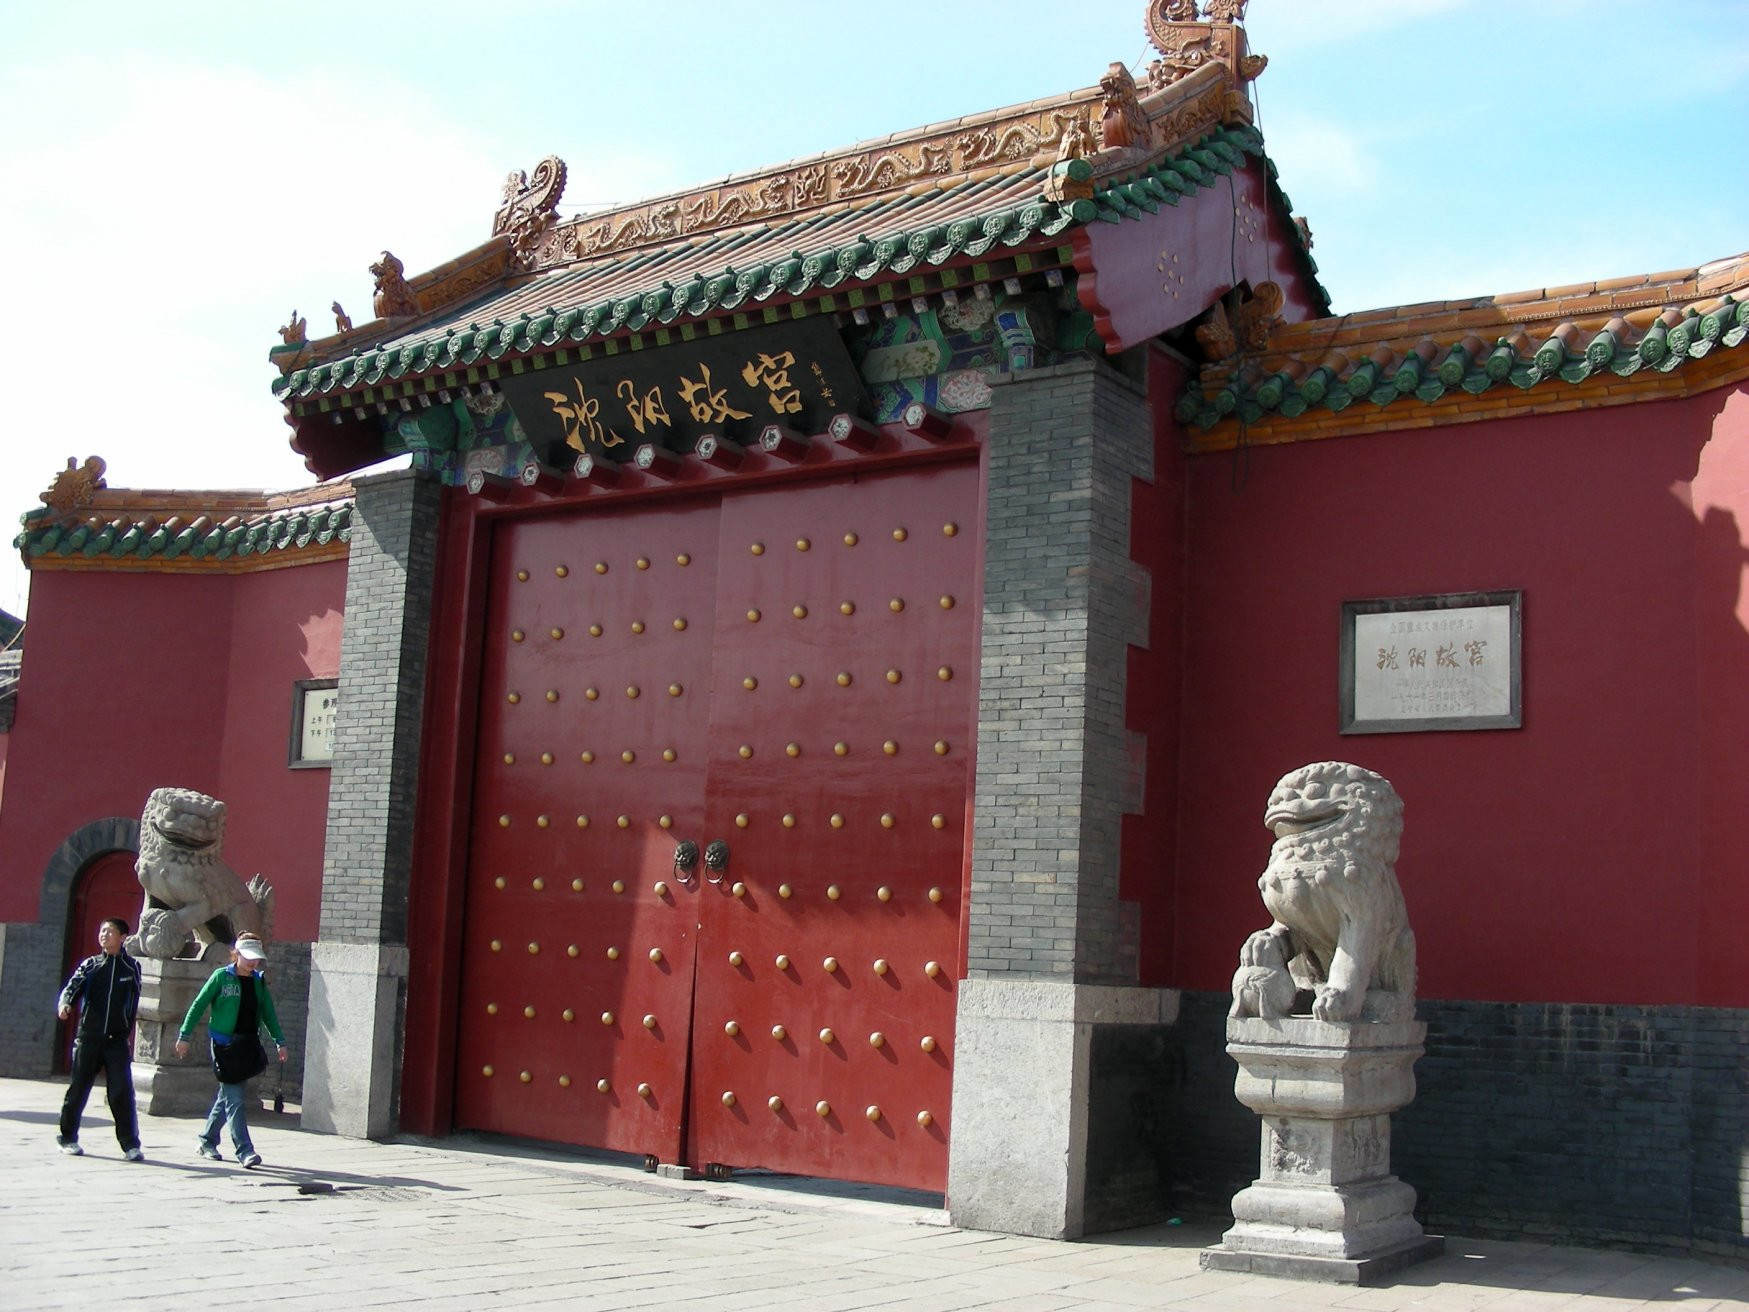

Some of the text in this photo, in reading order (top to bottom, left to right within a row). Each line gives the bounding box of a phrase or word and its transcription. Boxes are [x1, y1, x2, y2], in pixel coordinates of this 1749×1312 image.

[544, 351, 803, 454] 沈阳故宫
[1376, 640, 1488, 671] 沈阳故宫
